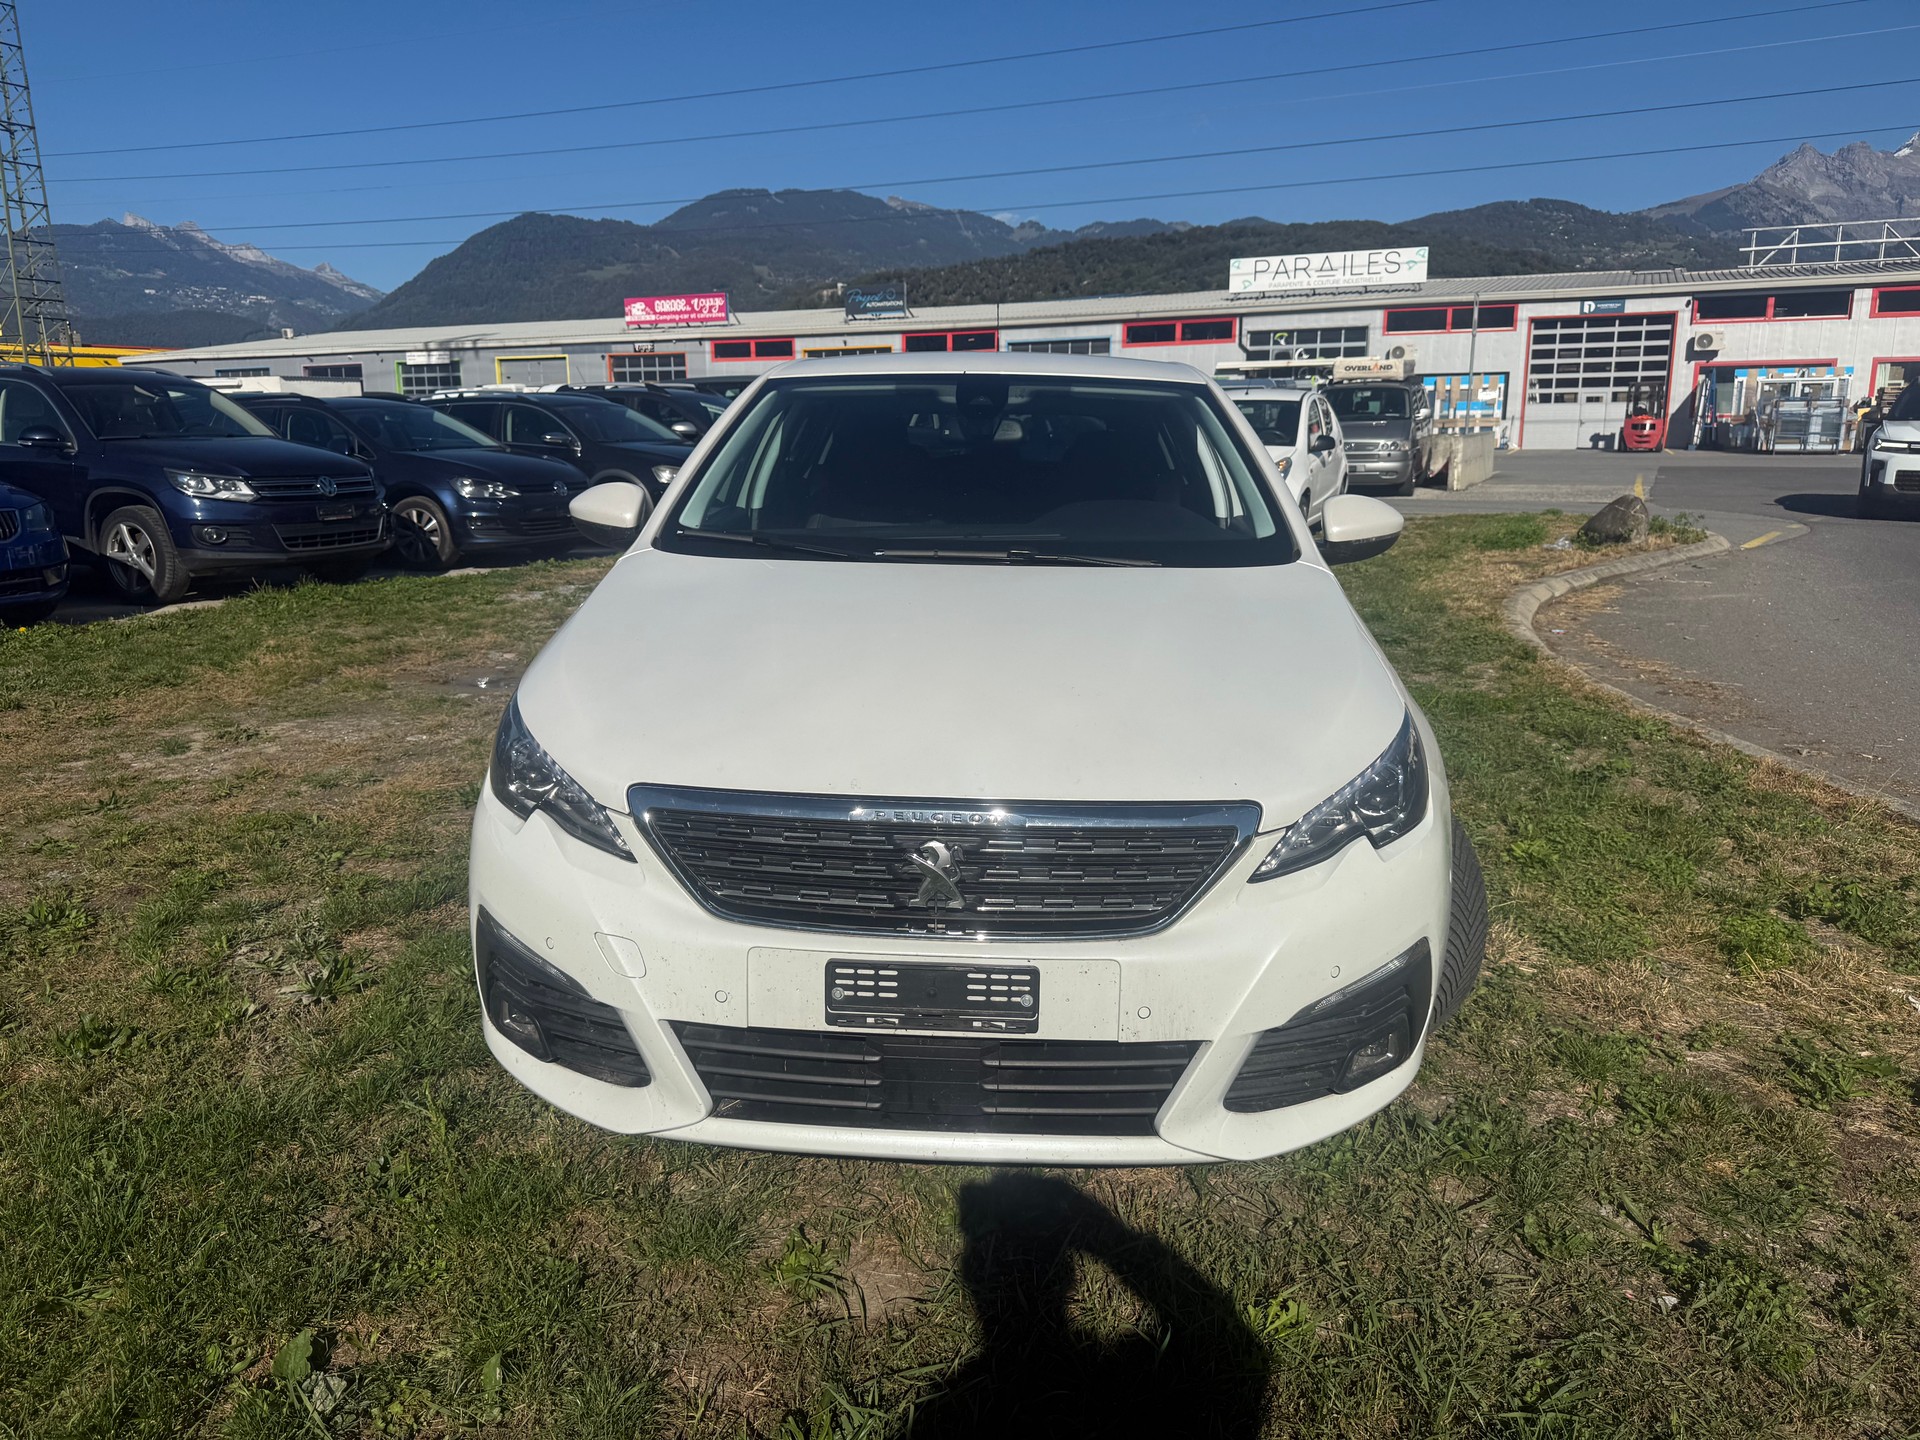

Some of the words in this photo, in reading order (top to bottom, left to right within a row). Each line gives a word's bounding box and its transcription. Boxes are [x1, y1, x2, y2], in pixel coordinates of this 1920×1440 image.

[1254, 251, 1401, 281] PARAILES
[1268, 280, 1303, 288] PARAPENTE
[1313, 278, 1339, 286] COUTURE
[1343, 276, 1383, 284] INDUSTRIELLE
[655, 299, 686, 312] GARAGE
[1344, 363, 1393, 372] OVERLAND
